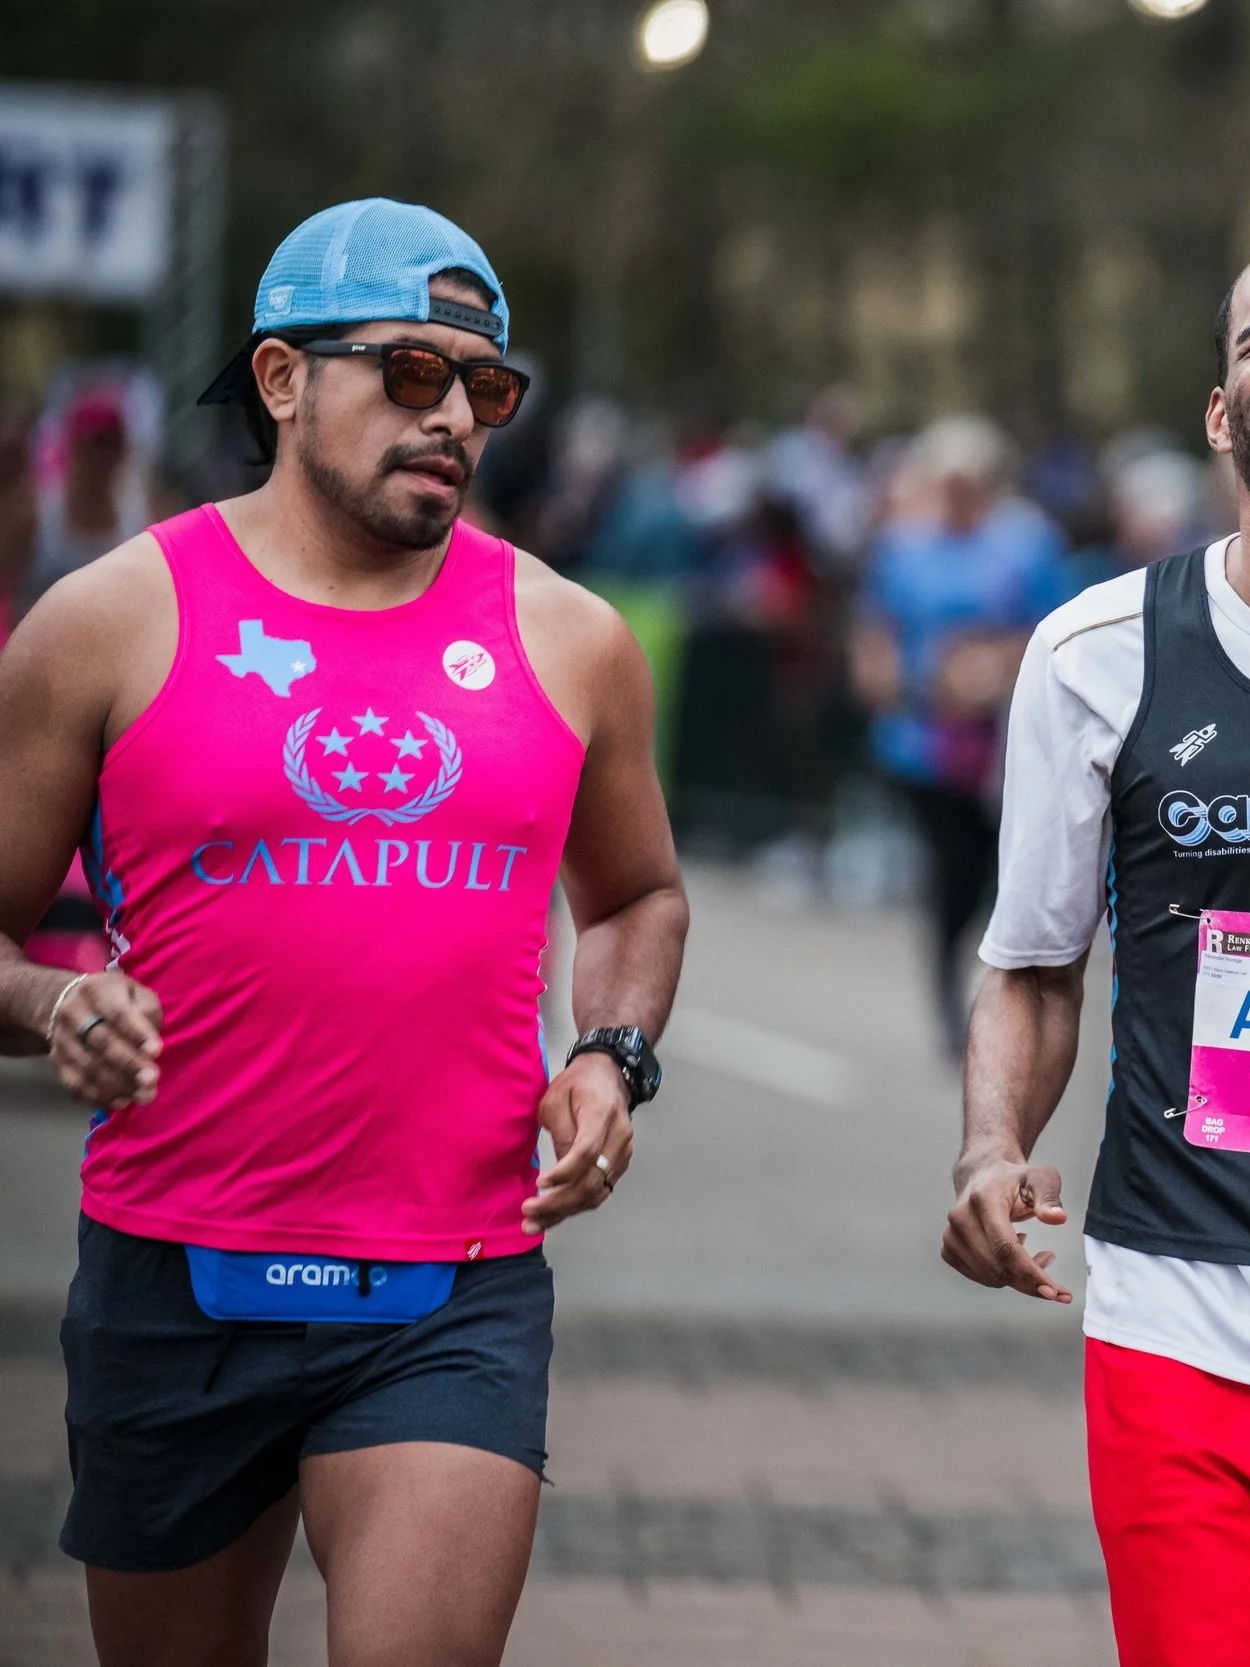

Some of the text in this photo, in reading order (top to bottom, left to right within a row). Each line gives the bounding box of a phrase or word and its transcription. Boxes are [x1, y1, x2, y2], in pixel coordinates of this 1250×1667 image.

[1173, 850, 1203, 859] Turning
[1204, 846, 1250, 857] disabilities
[191, 837, 528, 892] CATAPULT
[1206, 929, 1224, 954] R
[1205, 1117, 1223, 1126] BAG
[1201, 1125, 1225, 1134] DROP
[1205, 1134, 1219, 1143] 171
